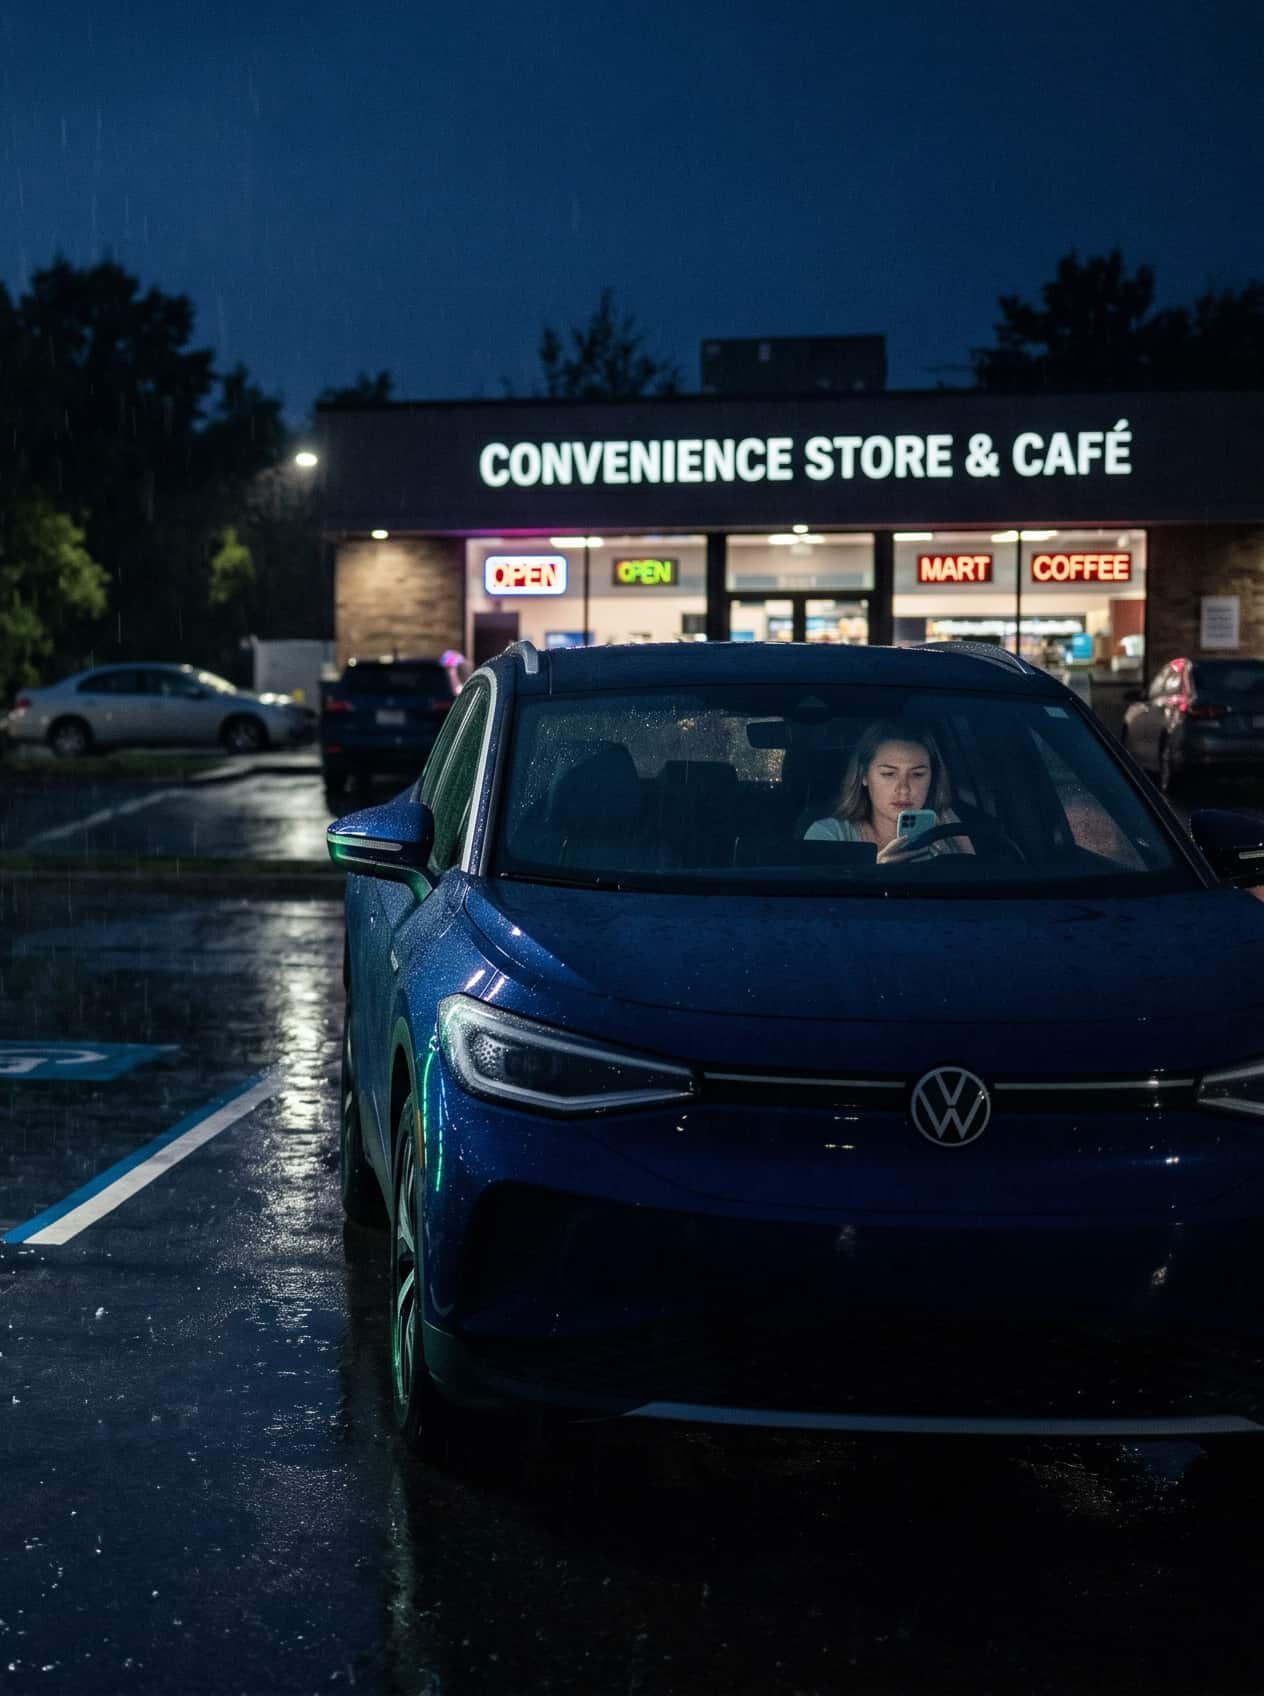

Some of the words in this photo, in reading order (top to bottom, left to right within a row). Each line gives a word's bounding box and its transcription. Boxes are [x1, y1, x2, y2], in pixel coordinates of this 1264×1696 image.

[479, 437, 794, 487] CONVENIENCE
[804, 434, 954, 481] STORE
[965, 433, 1000, 478] &
[1012, 418, 1133, 477] CAFÉ
[493, 562, 559, 588] OPEN
[616, 558, 672, 585] OPEN
[920, 555, 991, 582] MART
[1032, 553, 1130, 581] COFFEE
